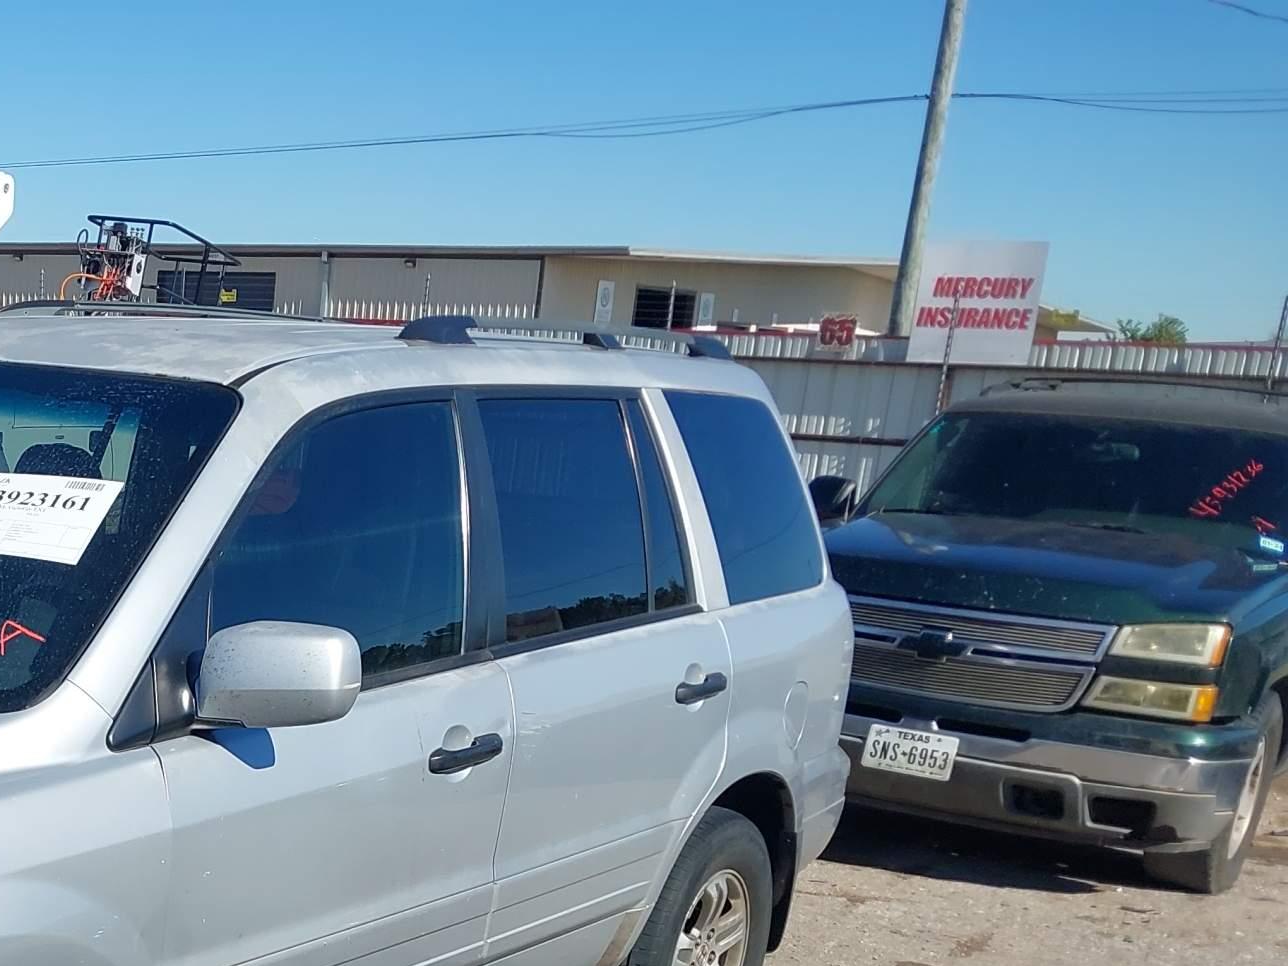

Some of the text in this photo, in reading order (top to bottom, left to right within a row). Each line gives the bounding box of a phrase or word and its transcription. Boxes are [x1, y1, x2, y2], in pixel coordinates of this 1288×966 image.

[932, 275, 1035, 300] MERCURY
[915, 306, 1033, 330] INSURANCE
[0, 620, 47, 656] A
[897, 730, 931, 743] TEXAS
